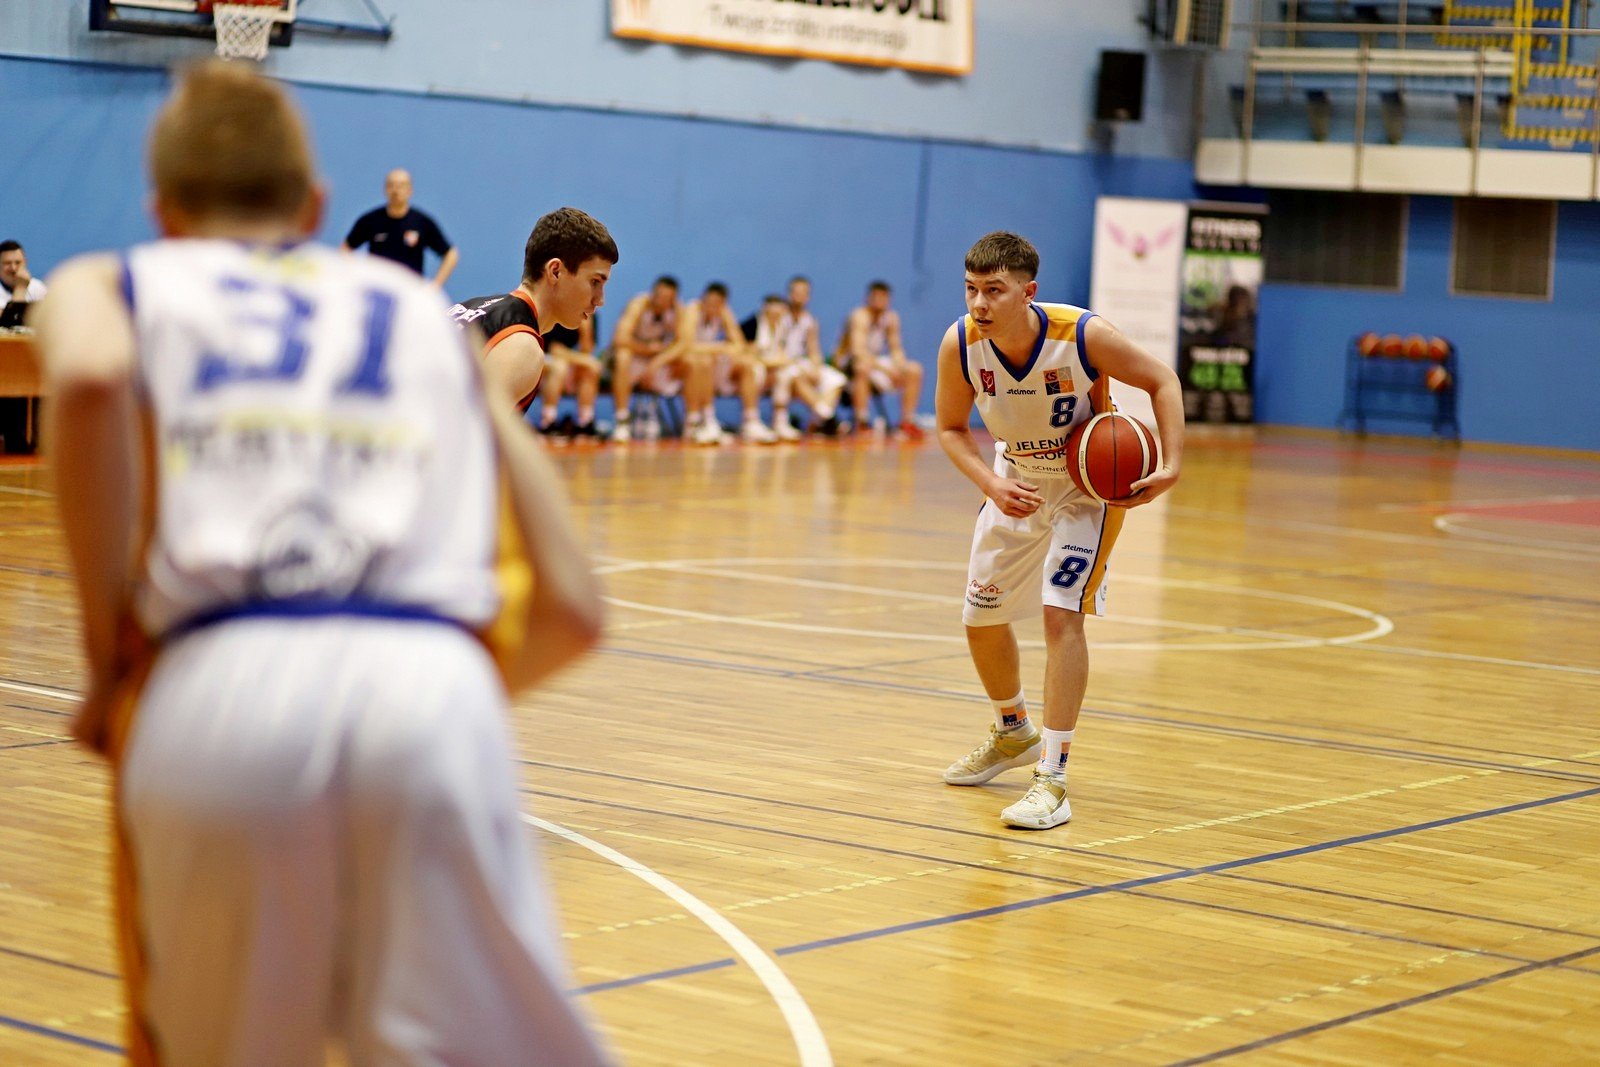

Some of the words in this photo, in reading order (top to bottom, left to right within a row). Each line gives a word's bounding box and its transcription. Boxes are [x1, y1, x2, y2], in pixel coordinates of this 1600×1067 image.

[193, 276, 400, 399] 31
[1049, 394, 1079, 429] 8
[1050, 555, 1090, 589] 8
